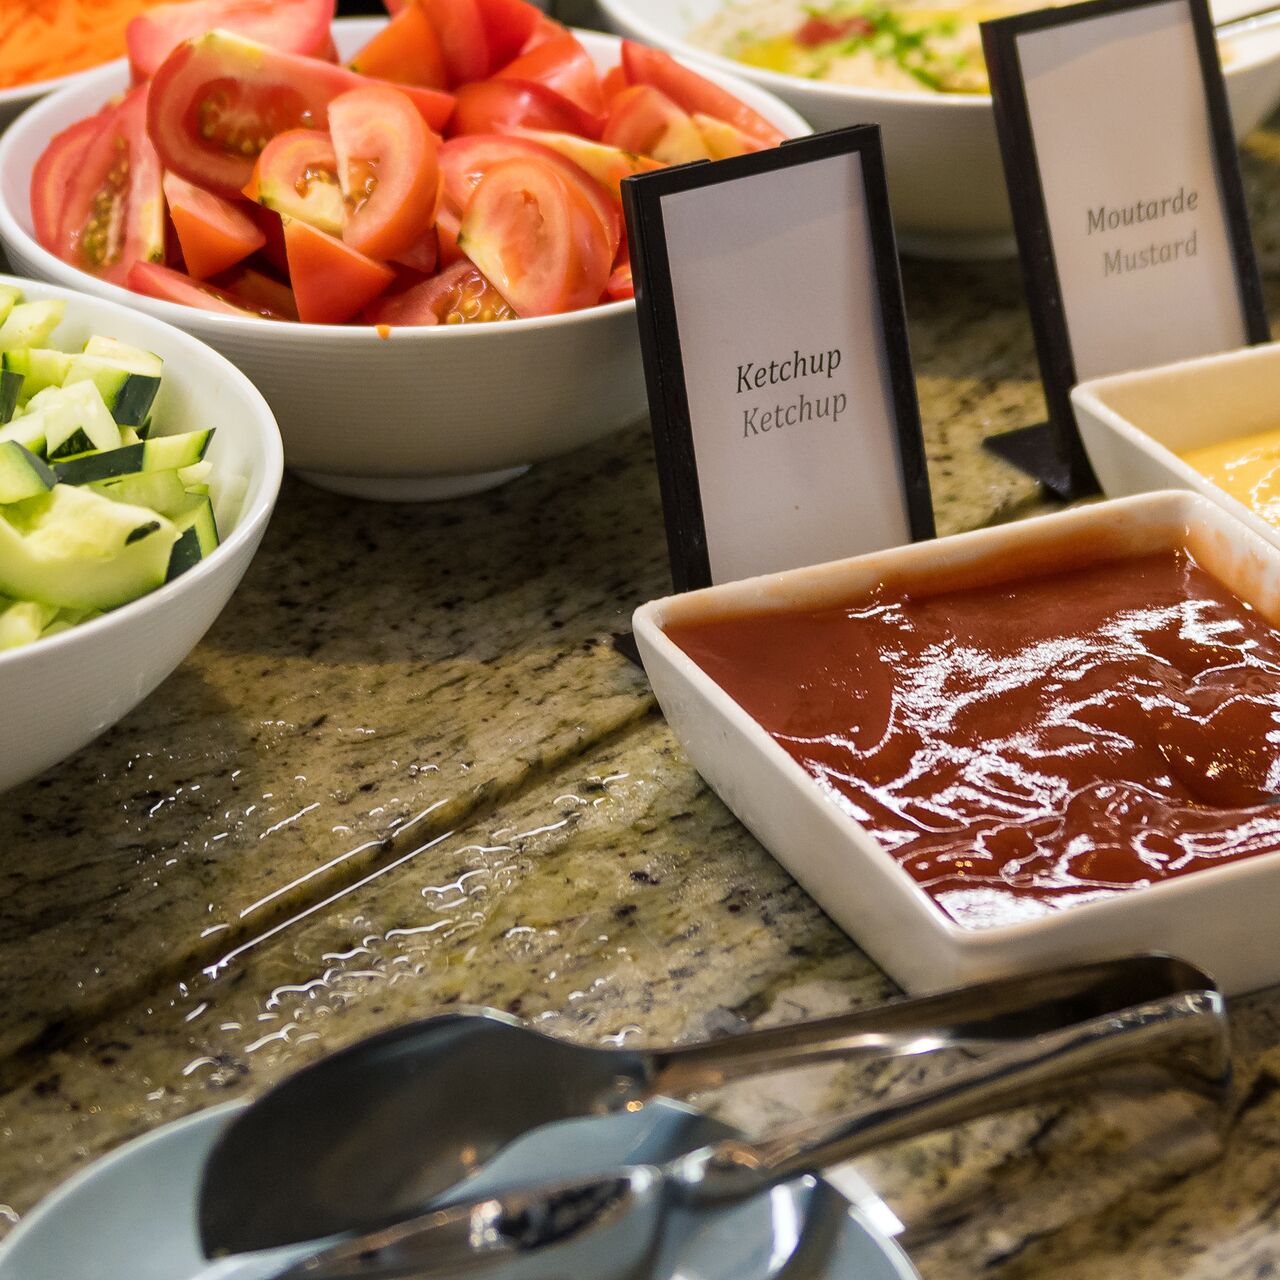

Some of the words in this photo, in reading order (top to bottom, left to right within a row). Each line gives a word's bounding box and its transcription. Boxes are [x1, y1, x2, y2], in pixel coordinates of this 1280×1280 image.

[1086, 186, 1200, 236] Moutarde
[1103, 230, 1199, 278] Mustard
[735, 346, 842, 394] Ketchup
[742, 391, 848, 439] Ketchup
